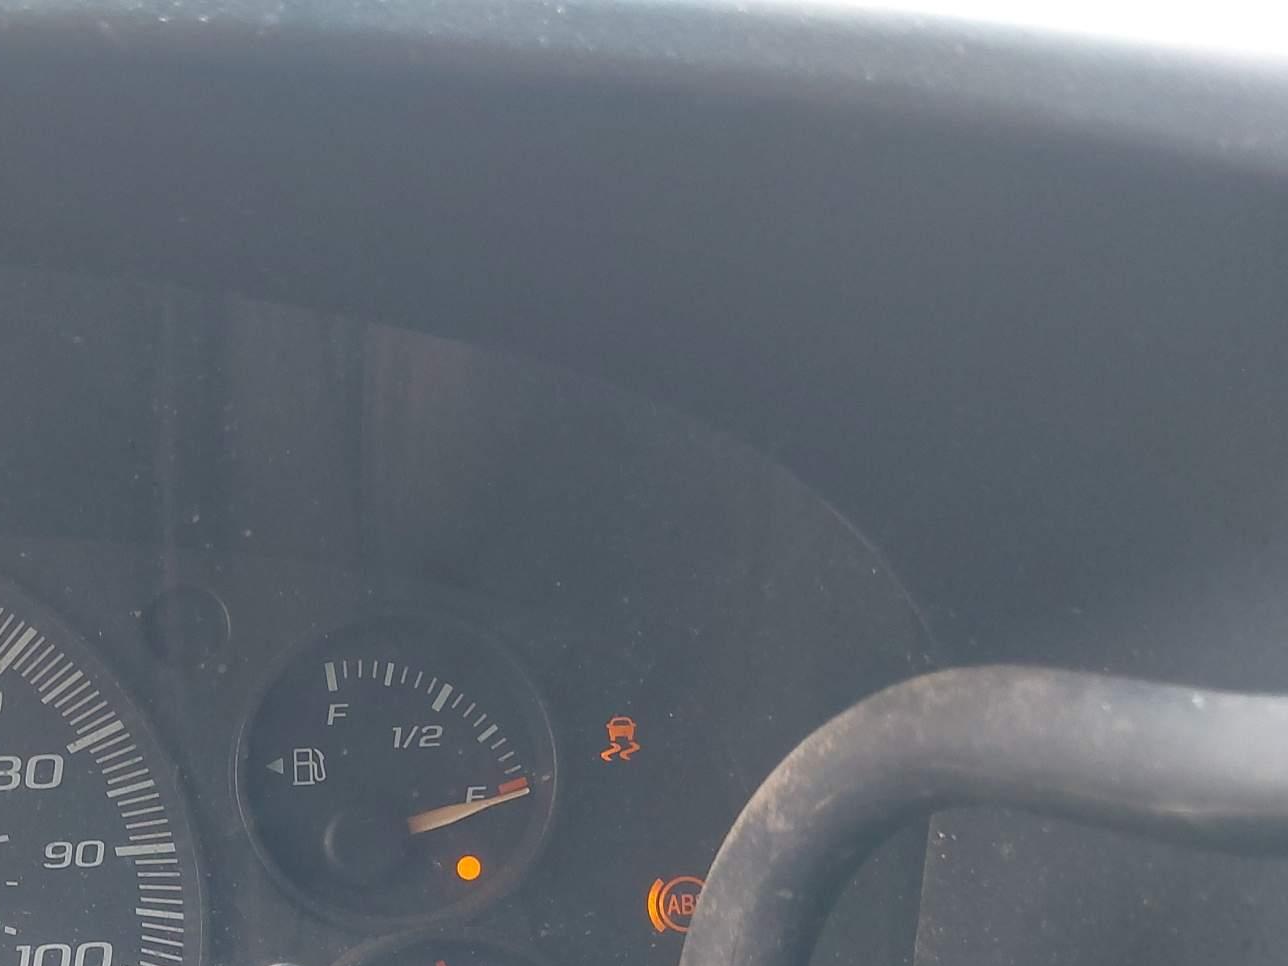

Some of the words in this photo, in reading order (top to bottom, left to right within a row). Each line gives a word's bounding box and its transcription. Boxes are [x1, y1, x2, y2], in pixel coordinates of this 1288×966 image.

[326, 704, 349, 725] F
[392, 725, 444, 749] 1/2
[43, 840, 105, 868] 90
[667, 893, 700, 917] AB
